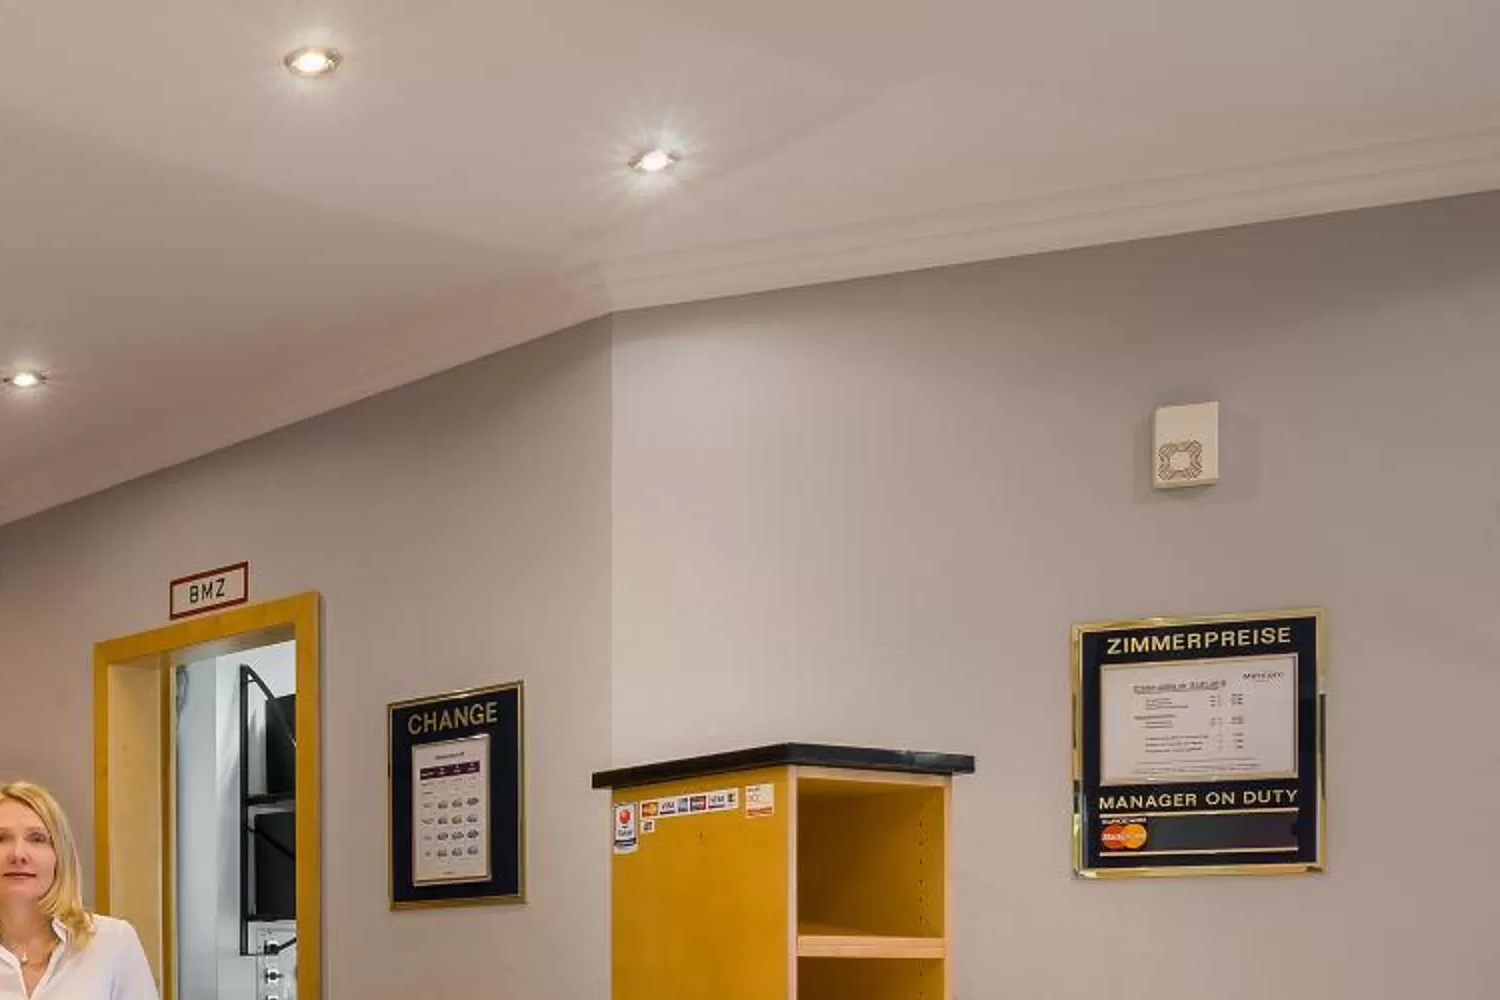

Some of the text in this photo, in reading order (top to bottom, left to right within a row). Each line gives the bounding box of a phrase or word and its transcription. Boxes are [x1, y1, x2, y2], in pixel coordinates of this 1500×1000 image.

[189, 578, 225, 603] BMZ
[1106, 627, 1292, 655] ZIMMERPREISE
[407, 701, 499, 735] CHANGE
[1098, 788, 1299, 811] MANAGER ON DUTY
